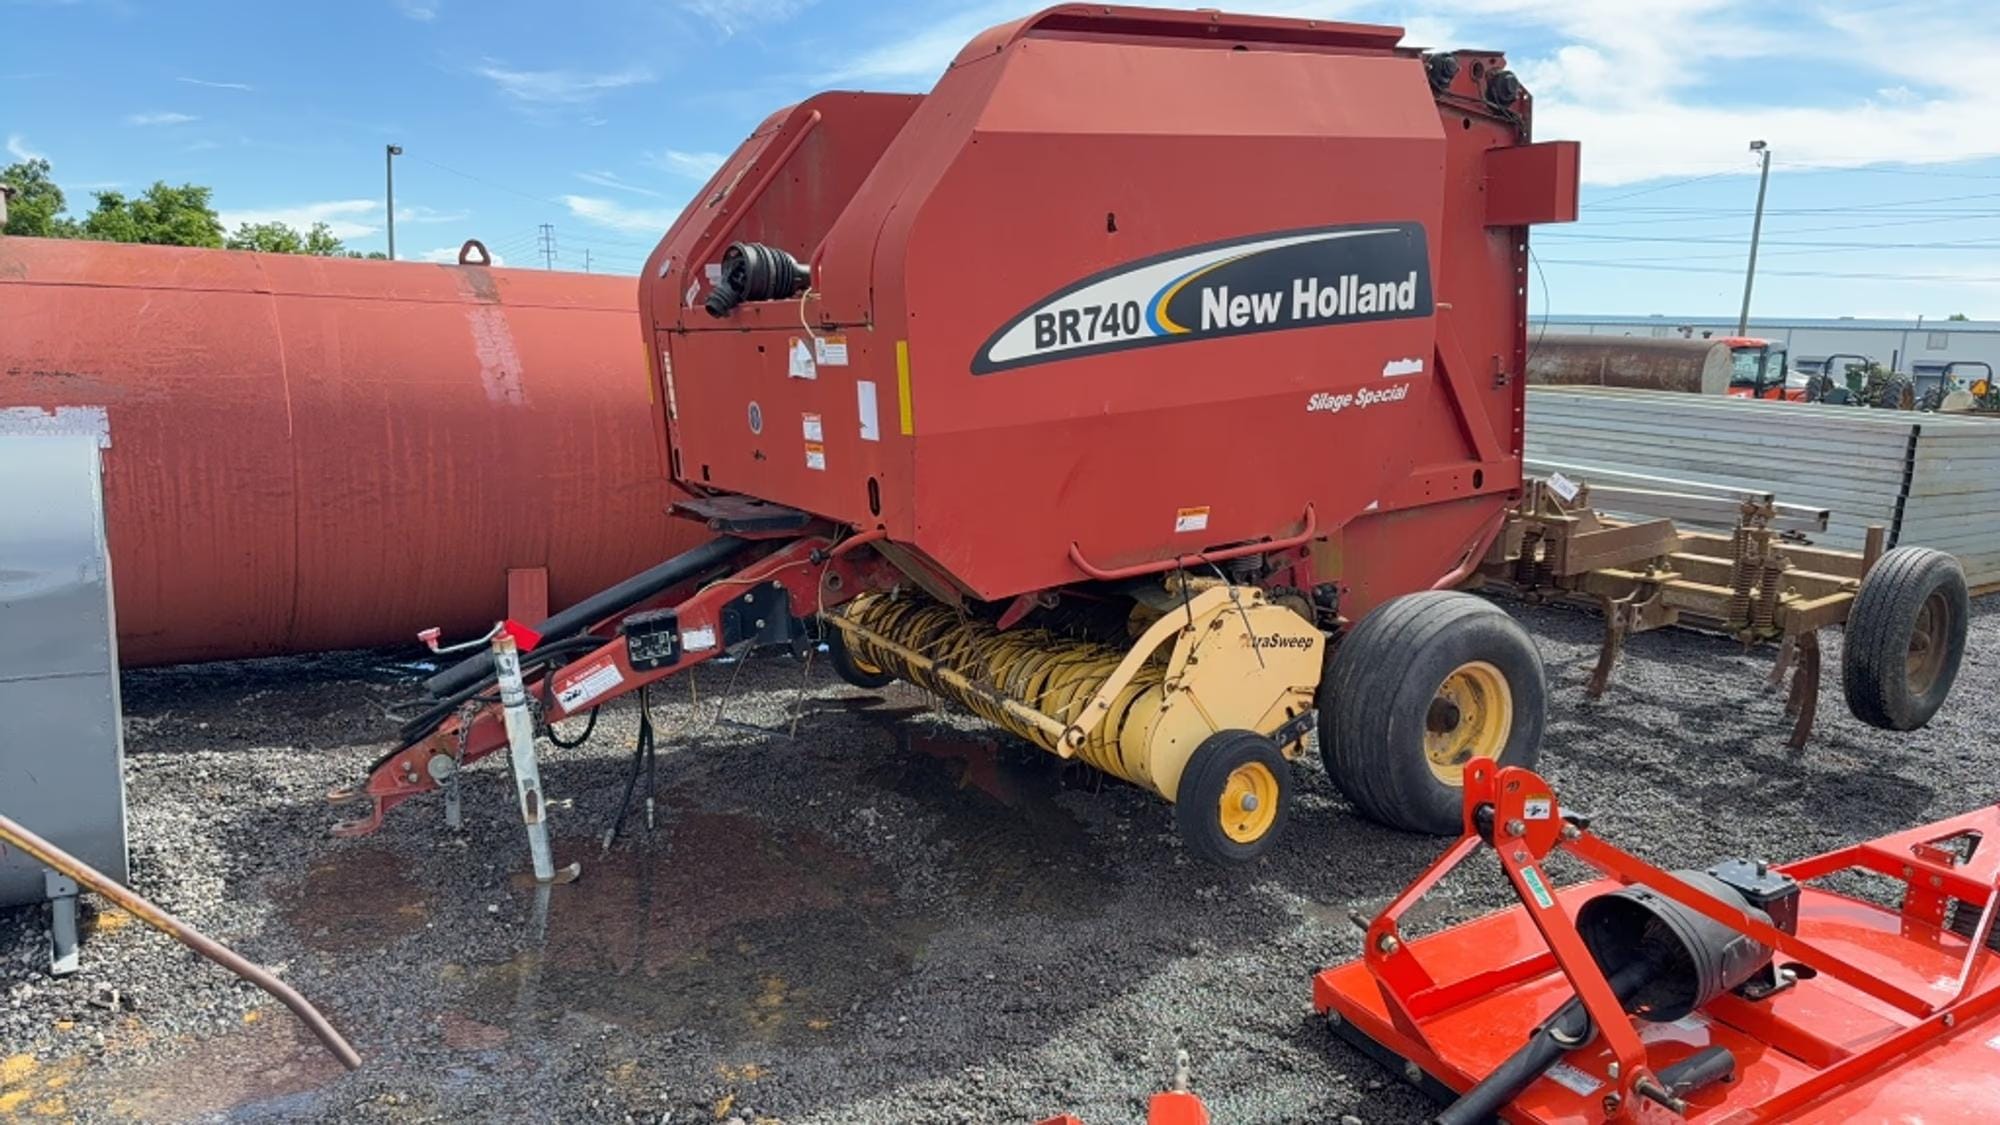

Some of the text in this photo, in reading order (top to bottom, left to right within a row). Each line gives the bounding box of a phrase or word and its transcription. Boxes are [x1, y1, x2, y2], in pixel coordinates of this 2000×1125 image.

[1034, 300, 1141, 350] BR740
[1201, 271, 1417, 331] New Holland
[1306, 383, 1409, 413] Silage Special
